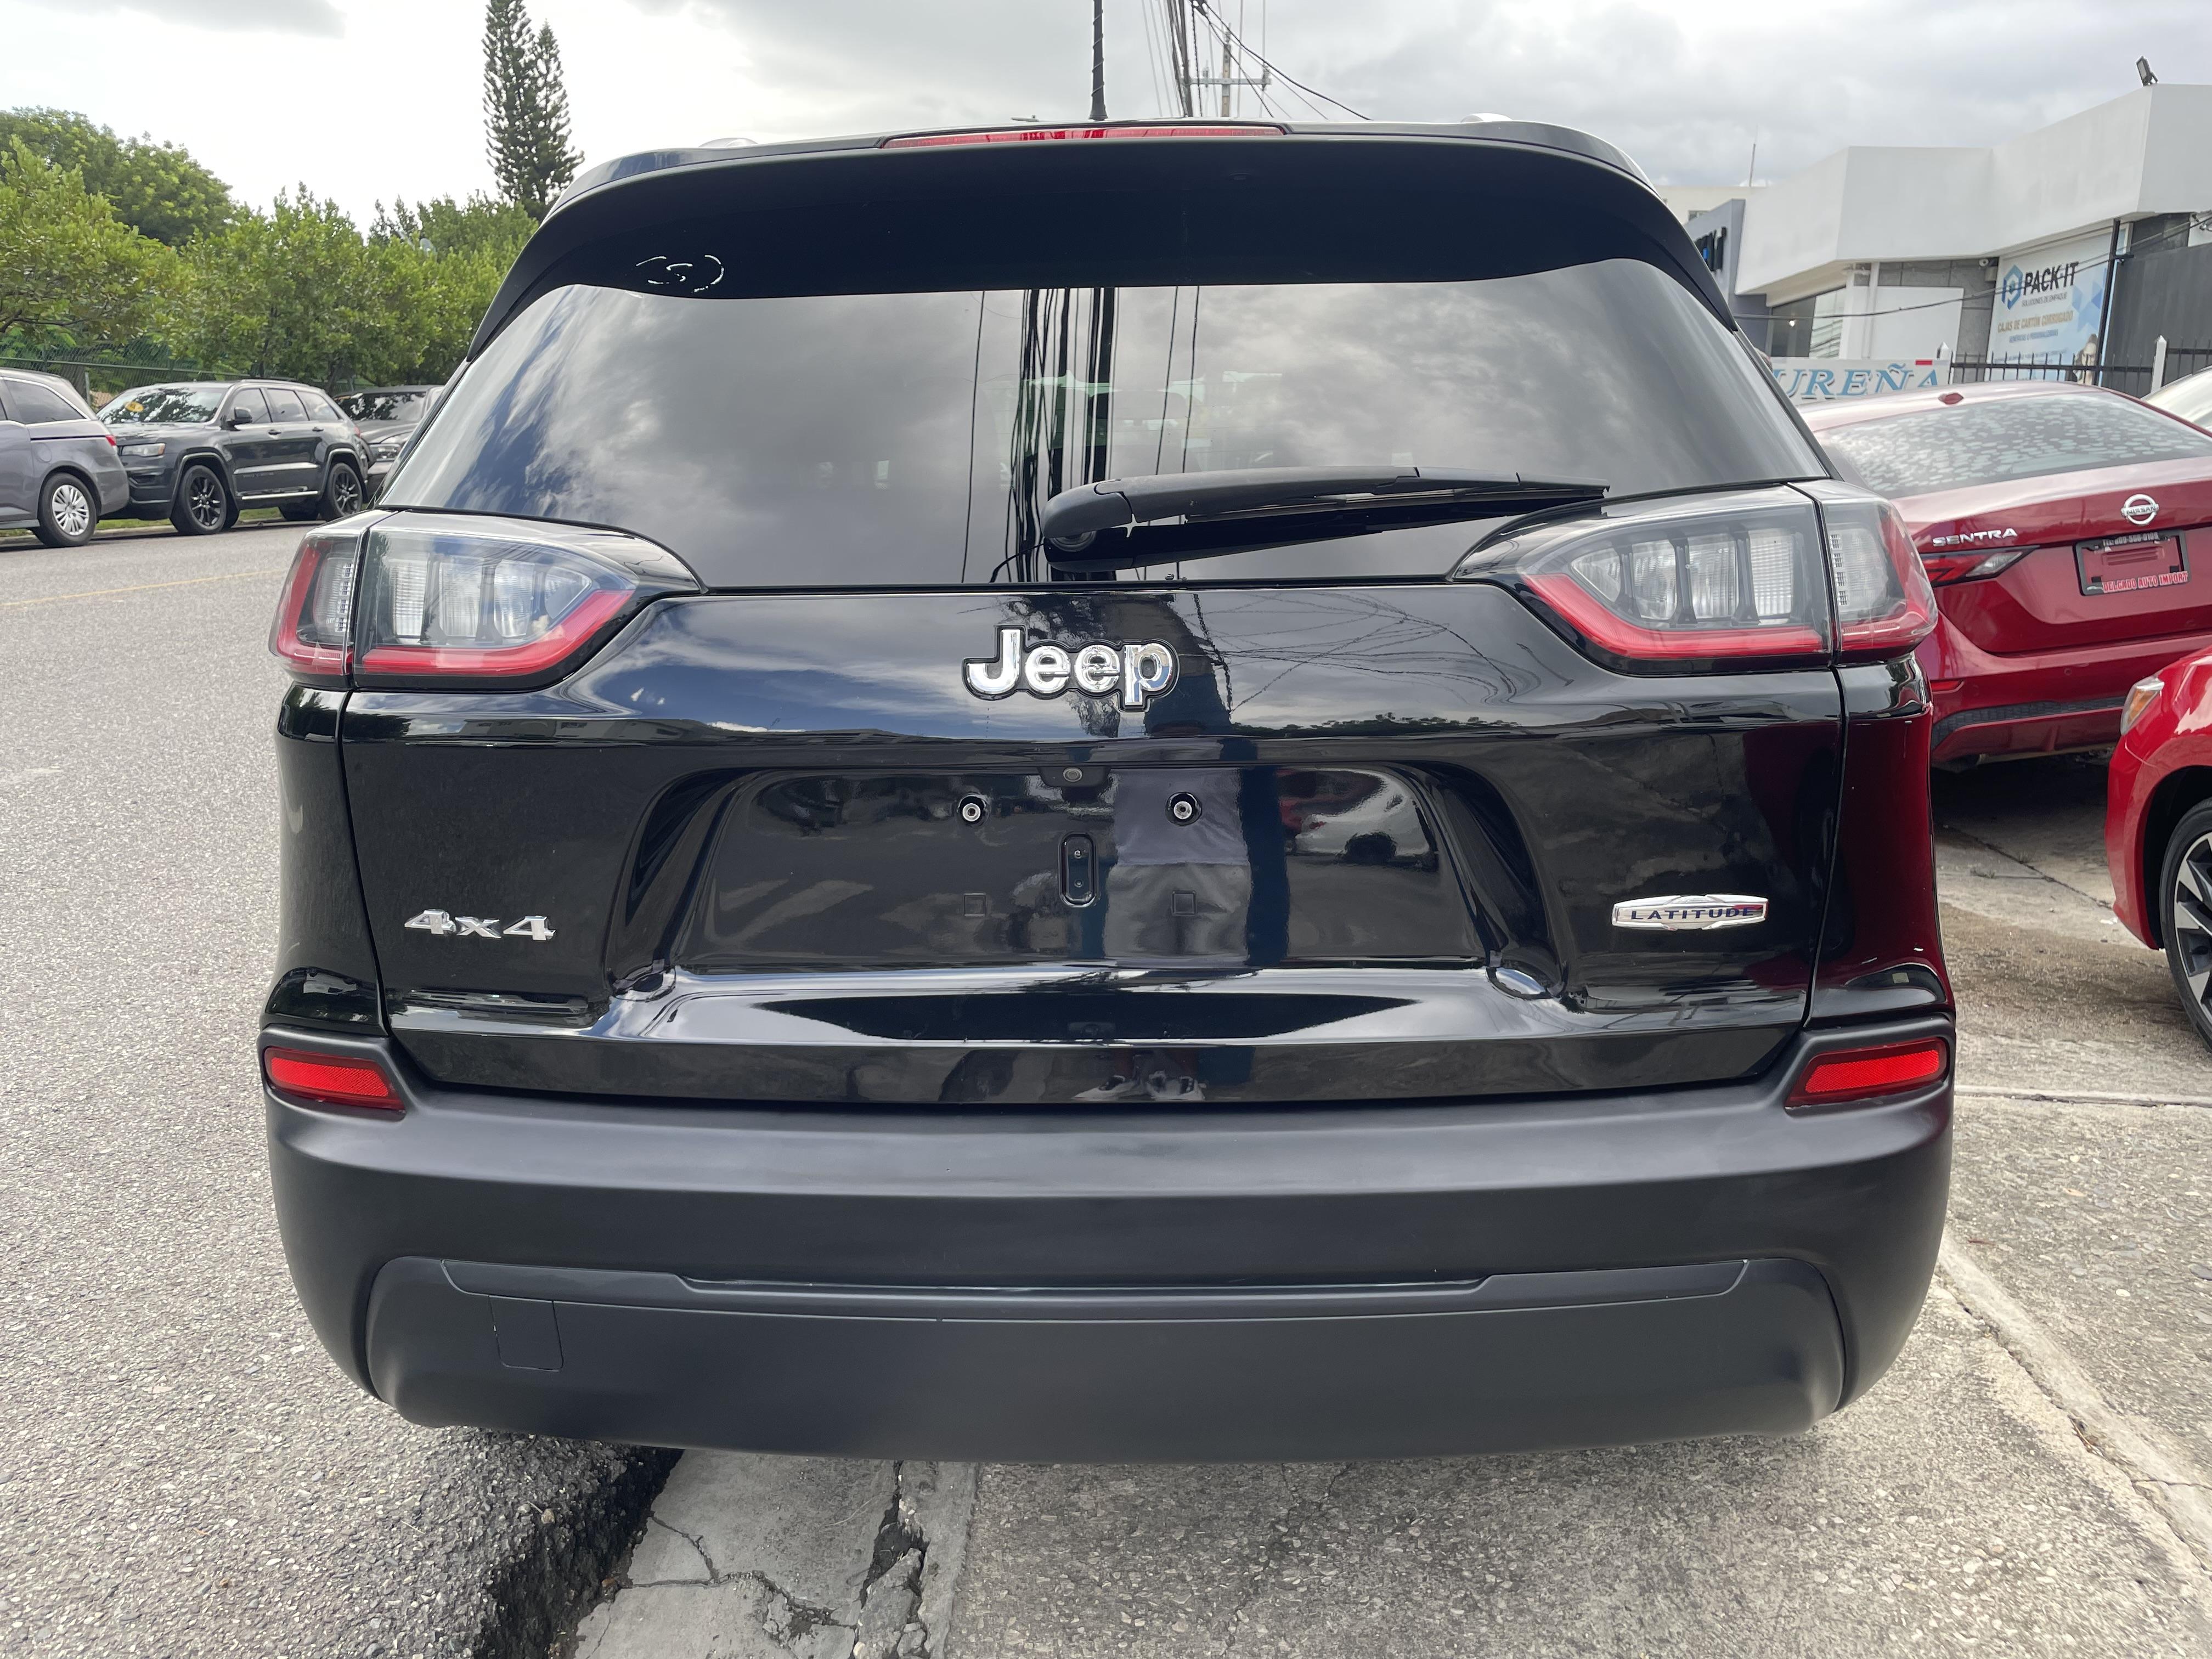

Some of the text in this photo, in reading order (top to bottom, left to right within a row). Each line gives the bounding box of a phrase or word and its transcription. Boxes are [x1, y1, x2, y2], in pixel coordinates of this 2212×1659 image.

[2126, 506, 2156, 515] NISSAN
[1932, 528, 2018, 548] SENTRA
[2103, 571, 2188, 592] DELGADO AUTO IMPORT
[966, 627, 1175, 708] Jeep
[1630, 906, 1754, 921] LATITUDE
